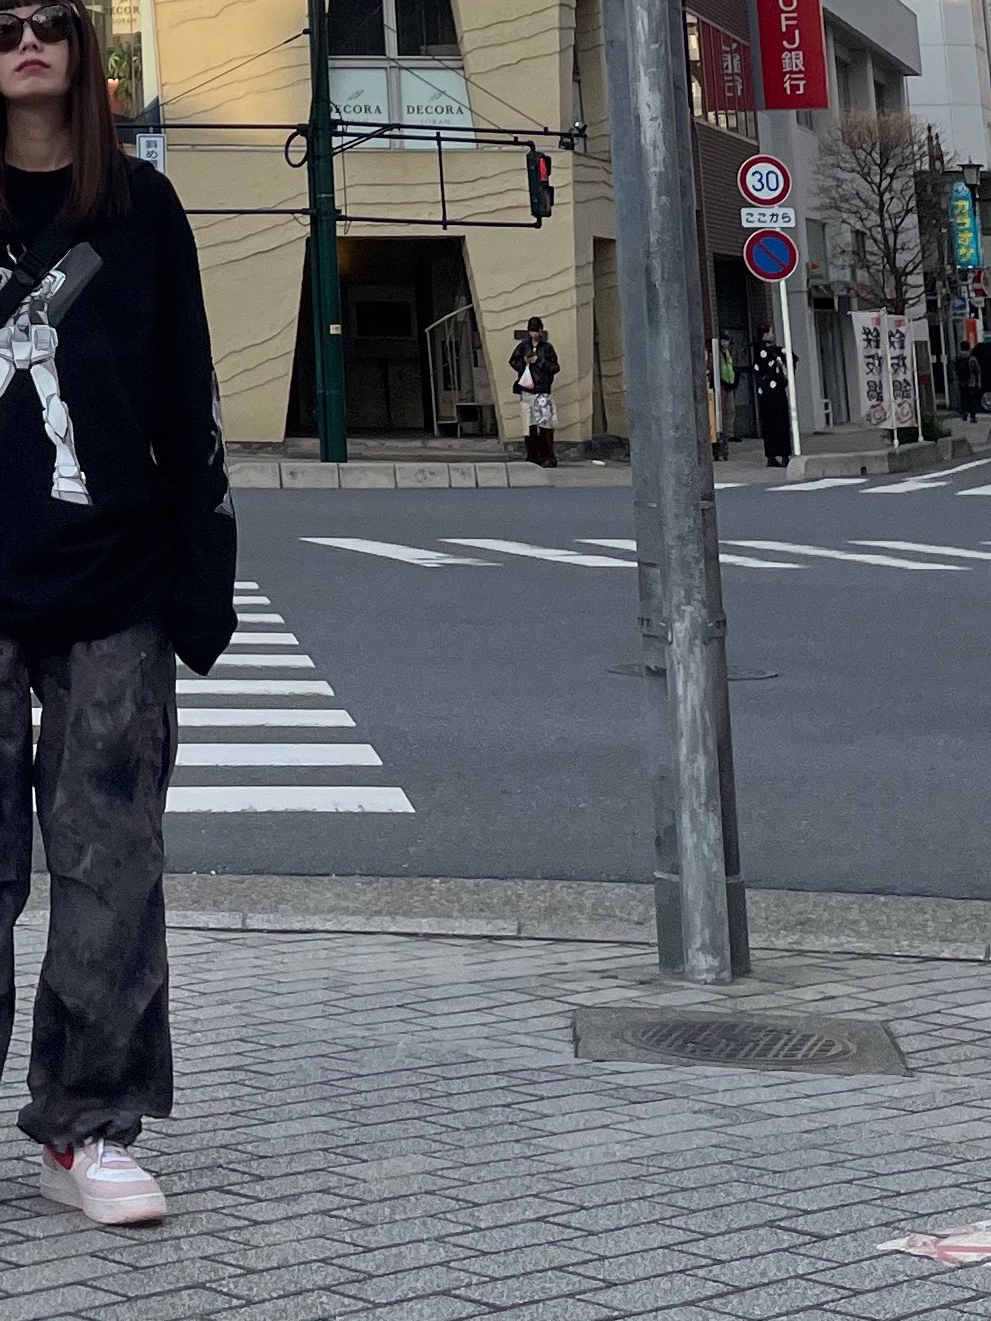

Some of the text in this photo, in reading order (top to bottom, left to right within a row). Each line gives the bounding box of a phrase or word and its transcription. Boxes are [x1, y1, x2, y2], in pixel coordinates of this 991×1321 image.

[406, 104, 464, 115] DECORA
[751, 170, 780, 192] 30
[745, 211, 792, 225] ここから
